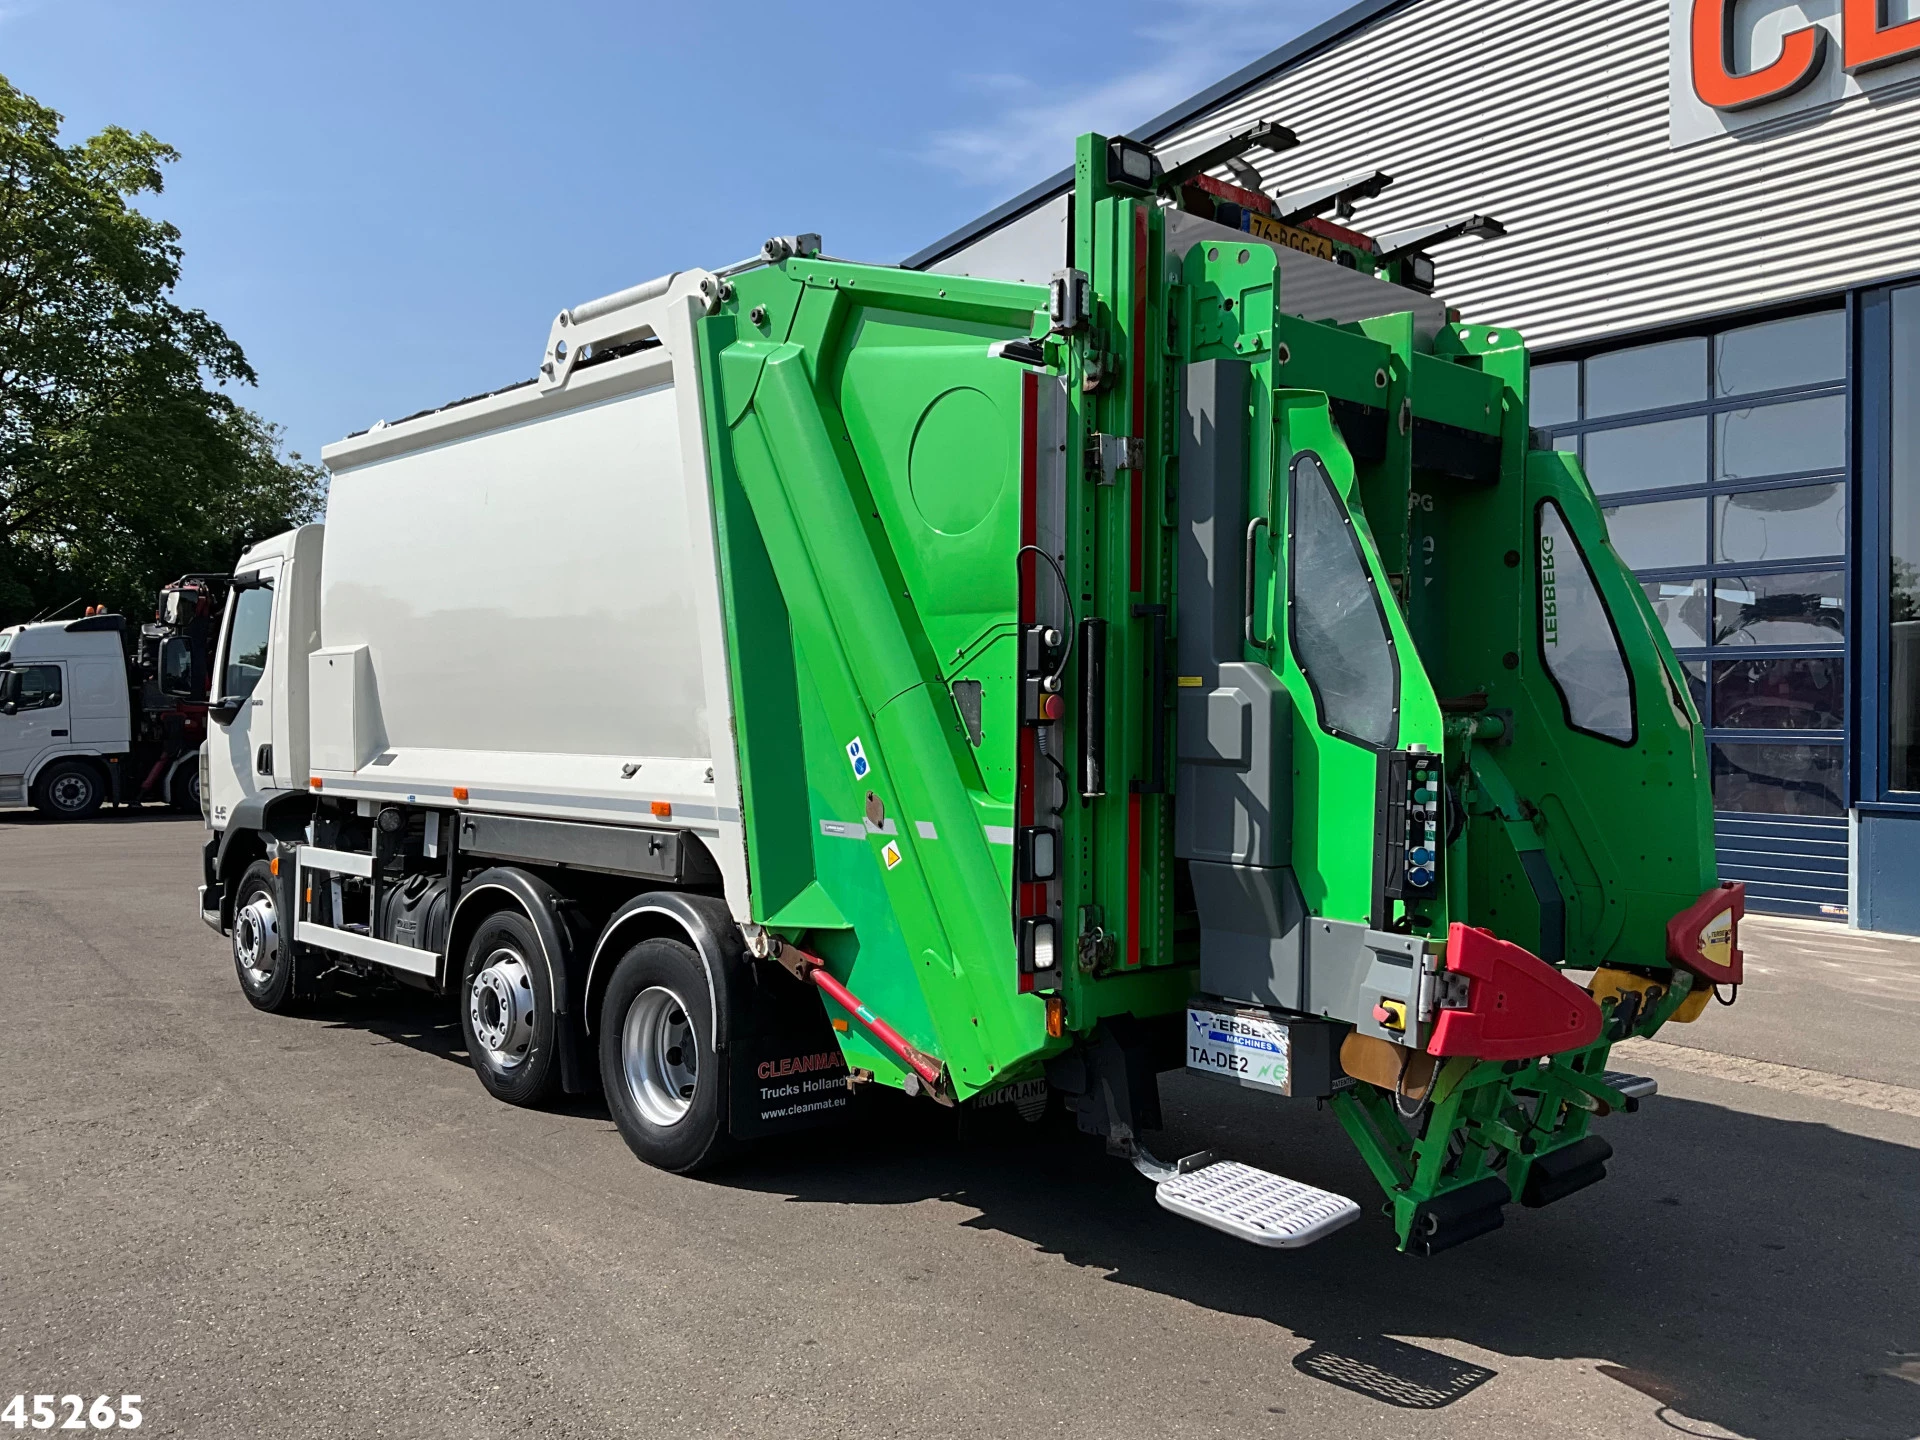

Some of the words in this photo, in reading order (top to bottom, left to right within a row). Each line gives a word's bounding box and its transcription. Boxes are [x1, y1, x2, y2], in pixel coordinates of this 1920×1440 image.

[1226, 1034, 1273, 1051] MACHINES
[1189, 1045, 1249, 1074] TA-DE2
[760, 1084, 800, 1100] Trucks
[802, 1074, 846, 1093] Holland
[760, 1097, 846, 1120] www.cleanmat.eu
